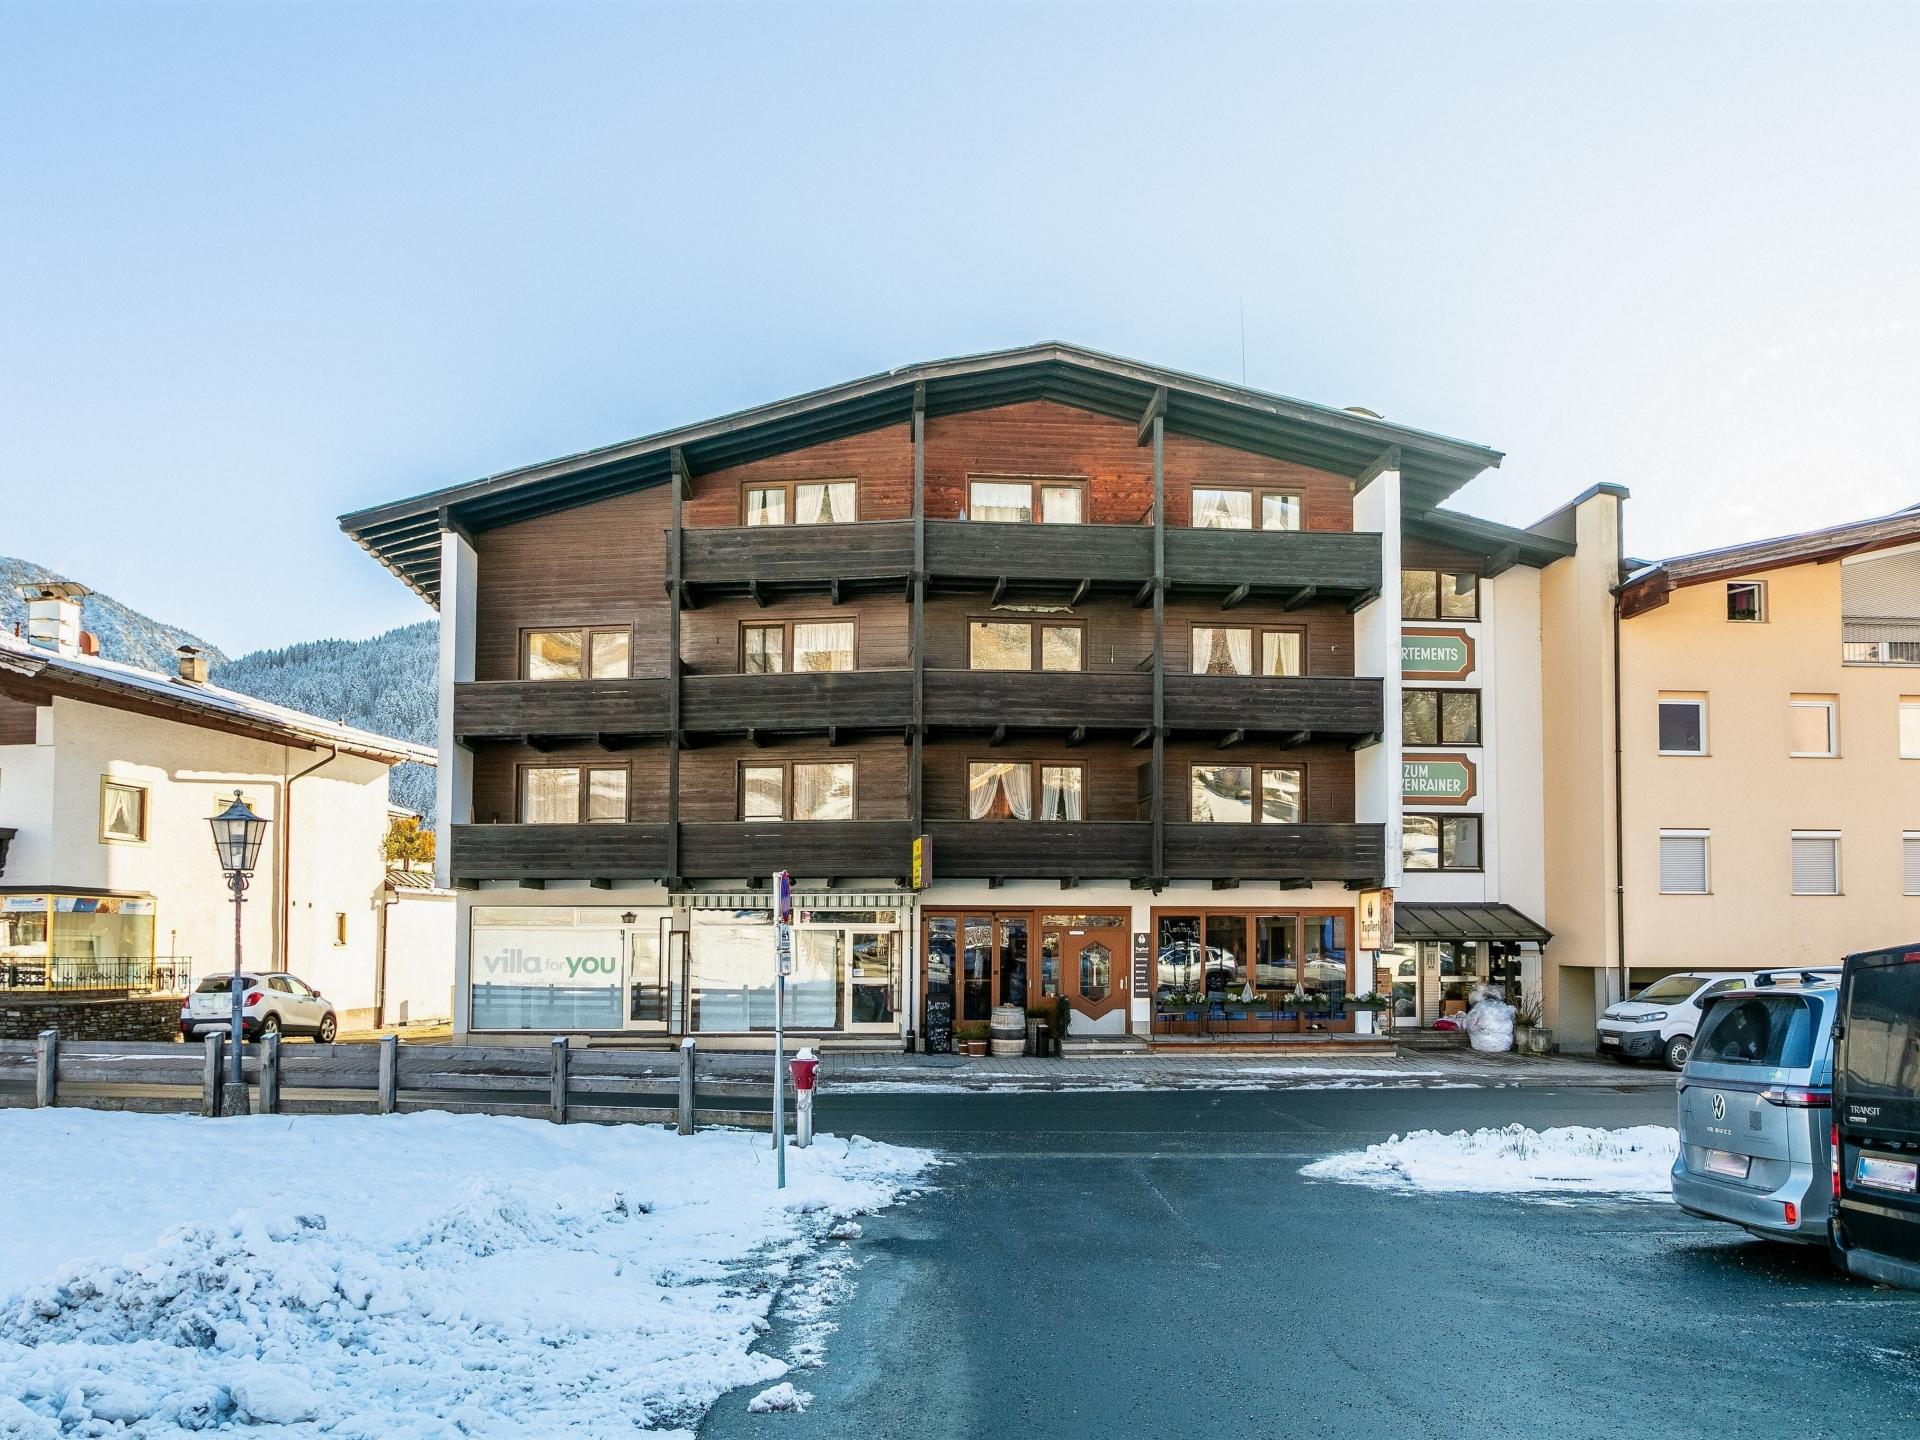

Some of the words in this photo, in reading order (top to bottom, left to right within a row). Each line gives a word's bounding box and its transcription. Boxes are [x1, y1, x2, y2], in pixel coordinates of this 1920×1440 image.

[1404, 765, 1429, 777] ZUM
[483, 948, 543, 973] villa
[545, 958, 565, 971] for
[565, 956, 616, 978] you
[1850, 1105, 1880, 1116] TRANSIT
